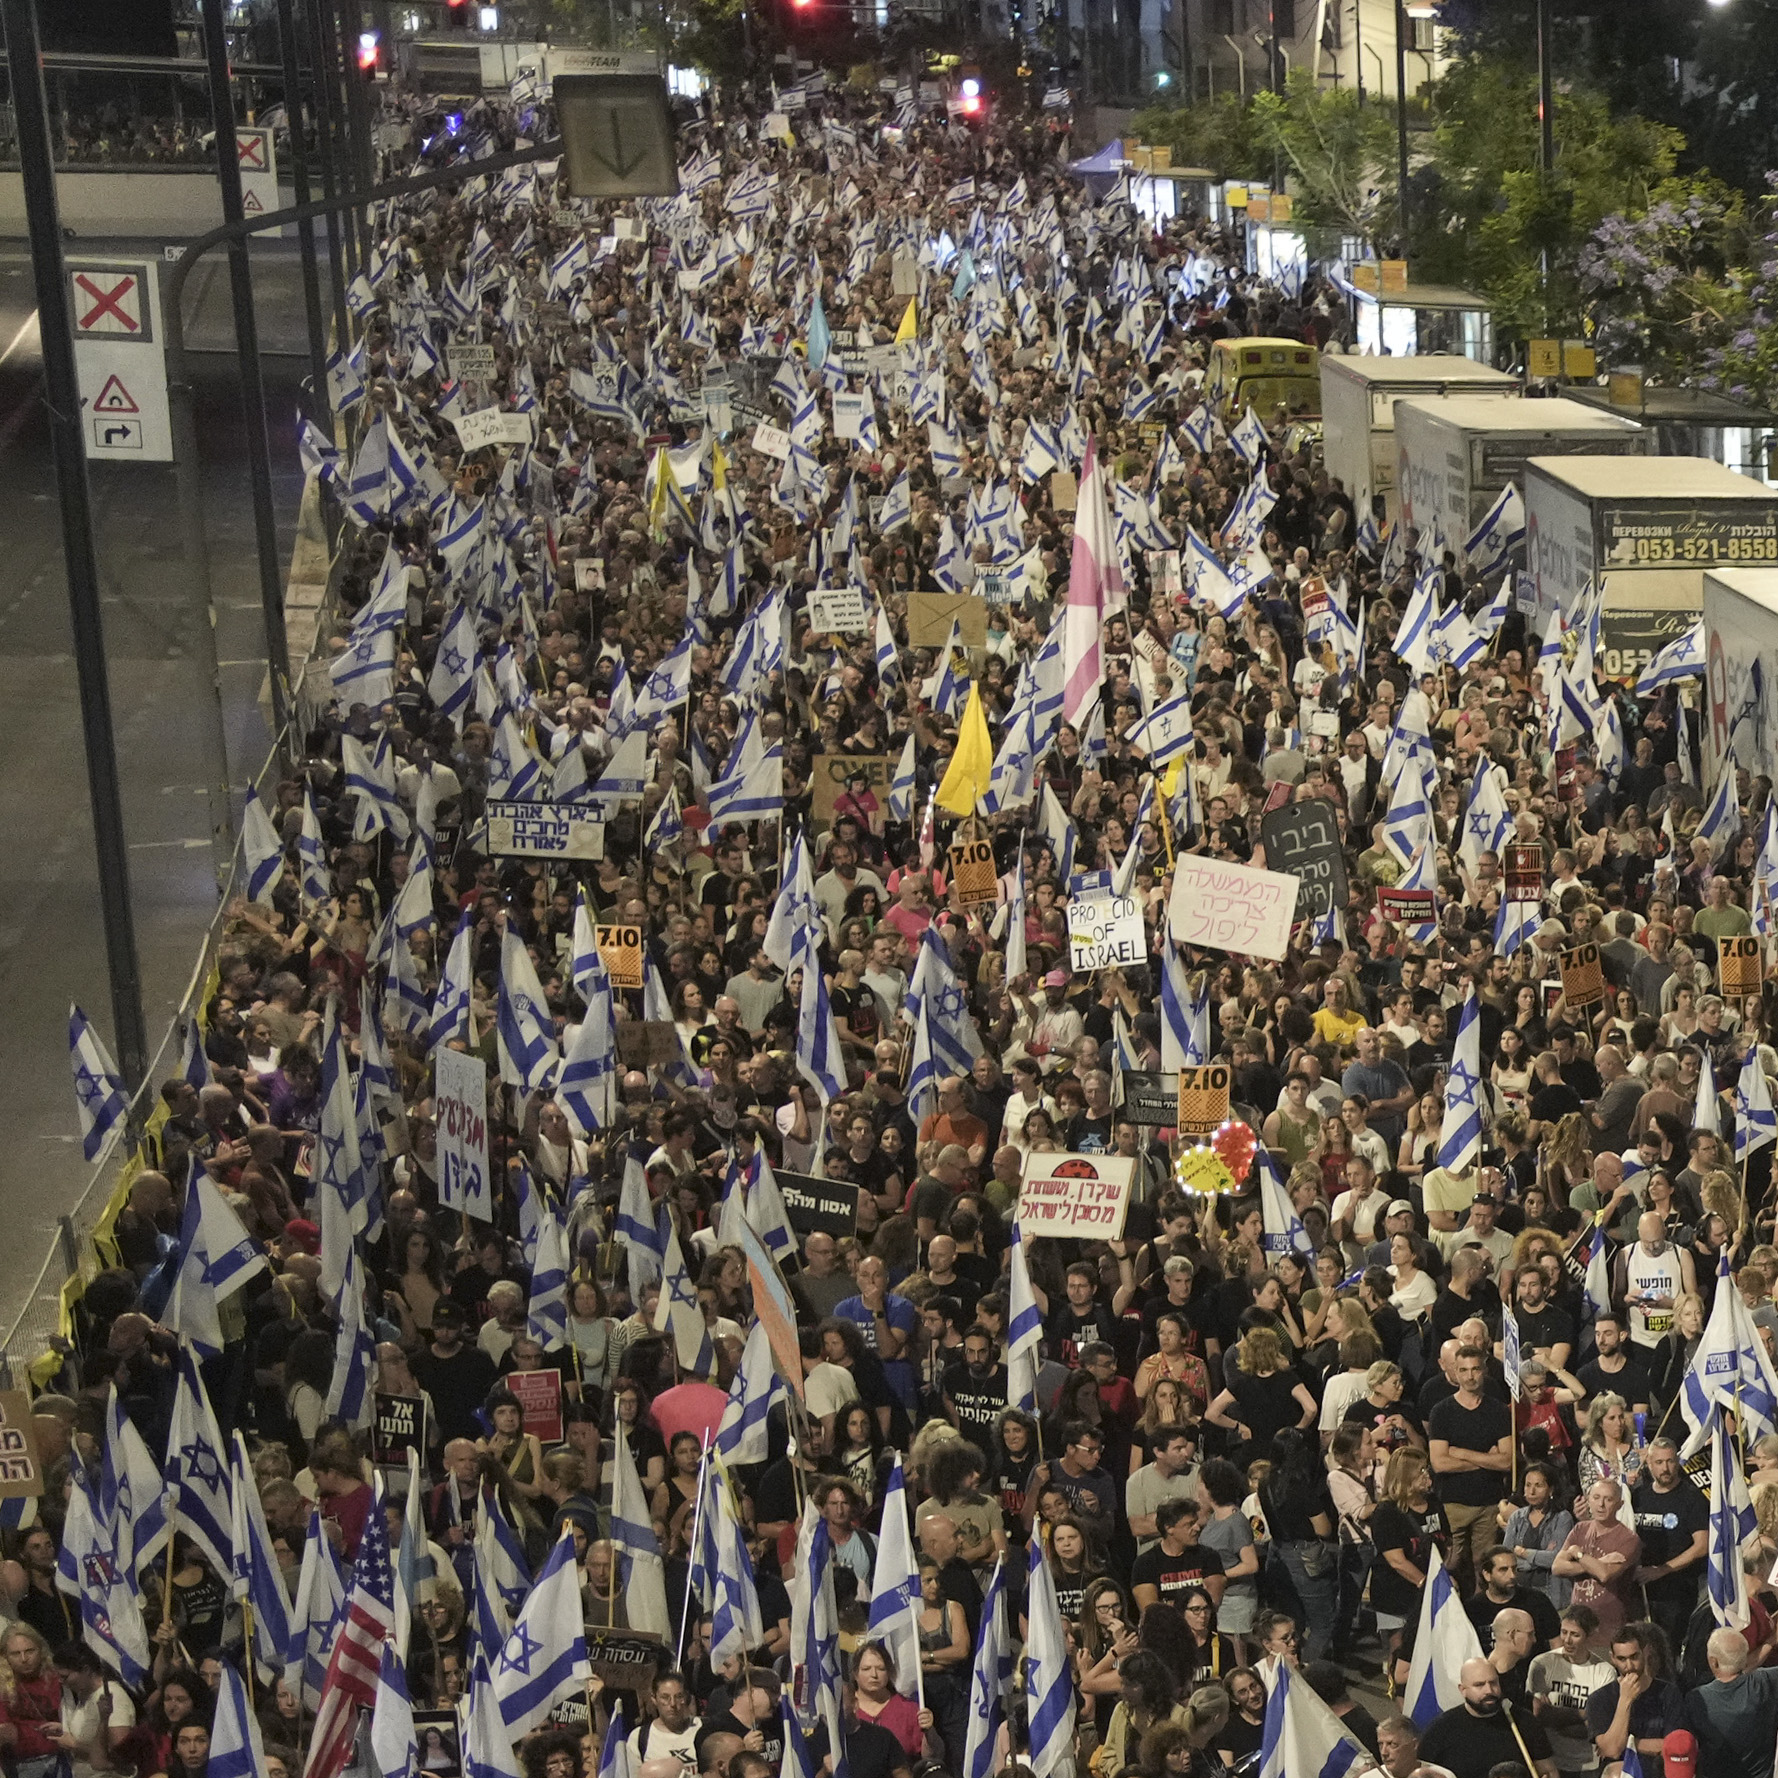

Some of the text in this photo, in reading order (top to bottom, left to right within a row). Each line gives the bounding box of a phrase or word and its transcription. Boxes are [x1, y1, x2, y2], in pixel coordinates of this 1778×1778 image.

[1612, 524, 1673, 538] ПЕРЕВОЗКИ
[1637, 538, 1778, 560] 053-521-8558
[1272, 819, 1333, 857] ביבי
[952, 842, 991, 866] 7.10
[1187, 865, 1281, 896] הממשלה
[1201, 893, 1267, 922] צריכה
[598, 927, 639, 948] 7.10
[1093, 922, 1116, 942] OF
[1188, 913, 1260, 946] ליפול
[1074, 940, 1146, 970] ISRAEL
[1560, 943, 1597, 970] 7.10
[1720, 938, 1758, 958] 7.10
[1181, 1068, 1227, 1091] 7.10
[819, 1197, 851, 1216] אסון
[1021, 1200, 1072, 1220] לישראל
[1635, 1276, 1672, 1290] חופשי
[391, 1399, 414, 1420] אל
[380, 1417, 415, 1435] תתנו
[1160, 1568, 1202, 1584] CRIME
